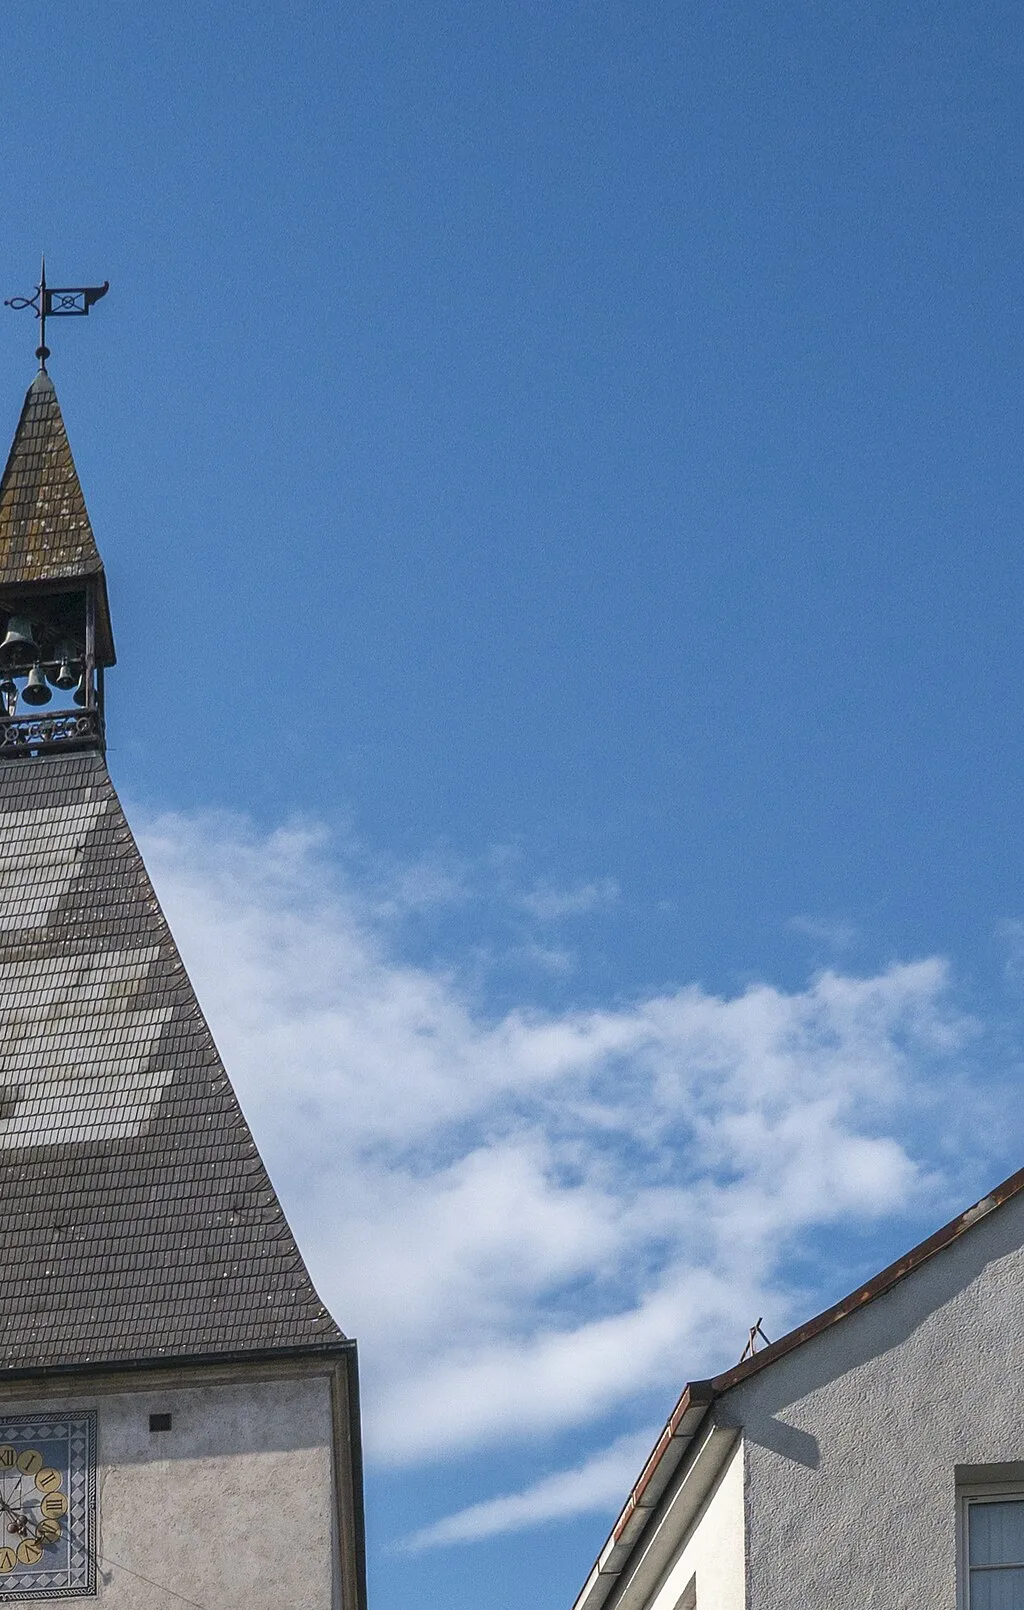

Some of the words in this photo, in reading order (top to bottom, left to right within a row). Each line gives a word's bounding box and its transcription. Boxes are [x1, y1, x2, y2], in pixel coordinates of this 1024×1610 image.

[25, 1454, 35, 1471] I
[40, 1471, 55, 1487] II
[46, 1499, 63, 1511] III
[24, 1544, 40, 1562] V
